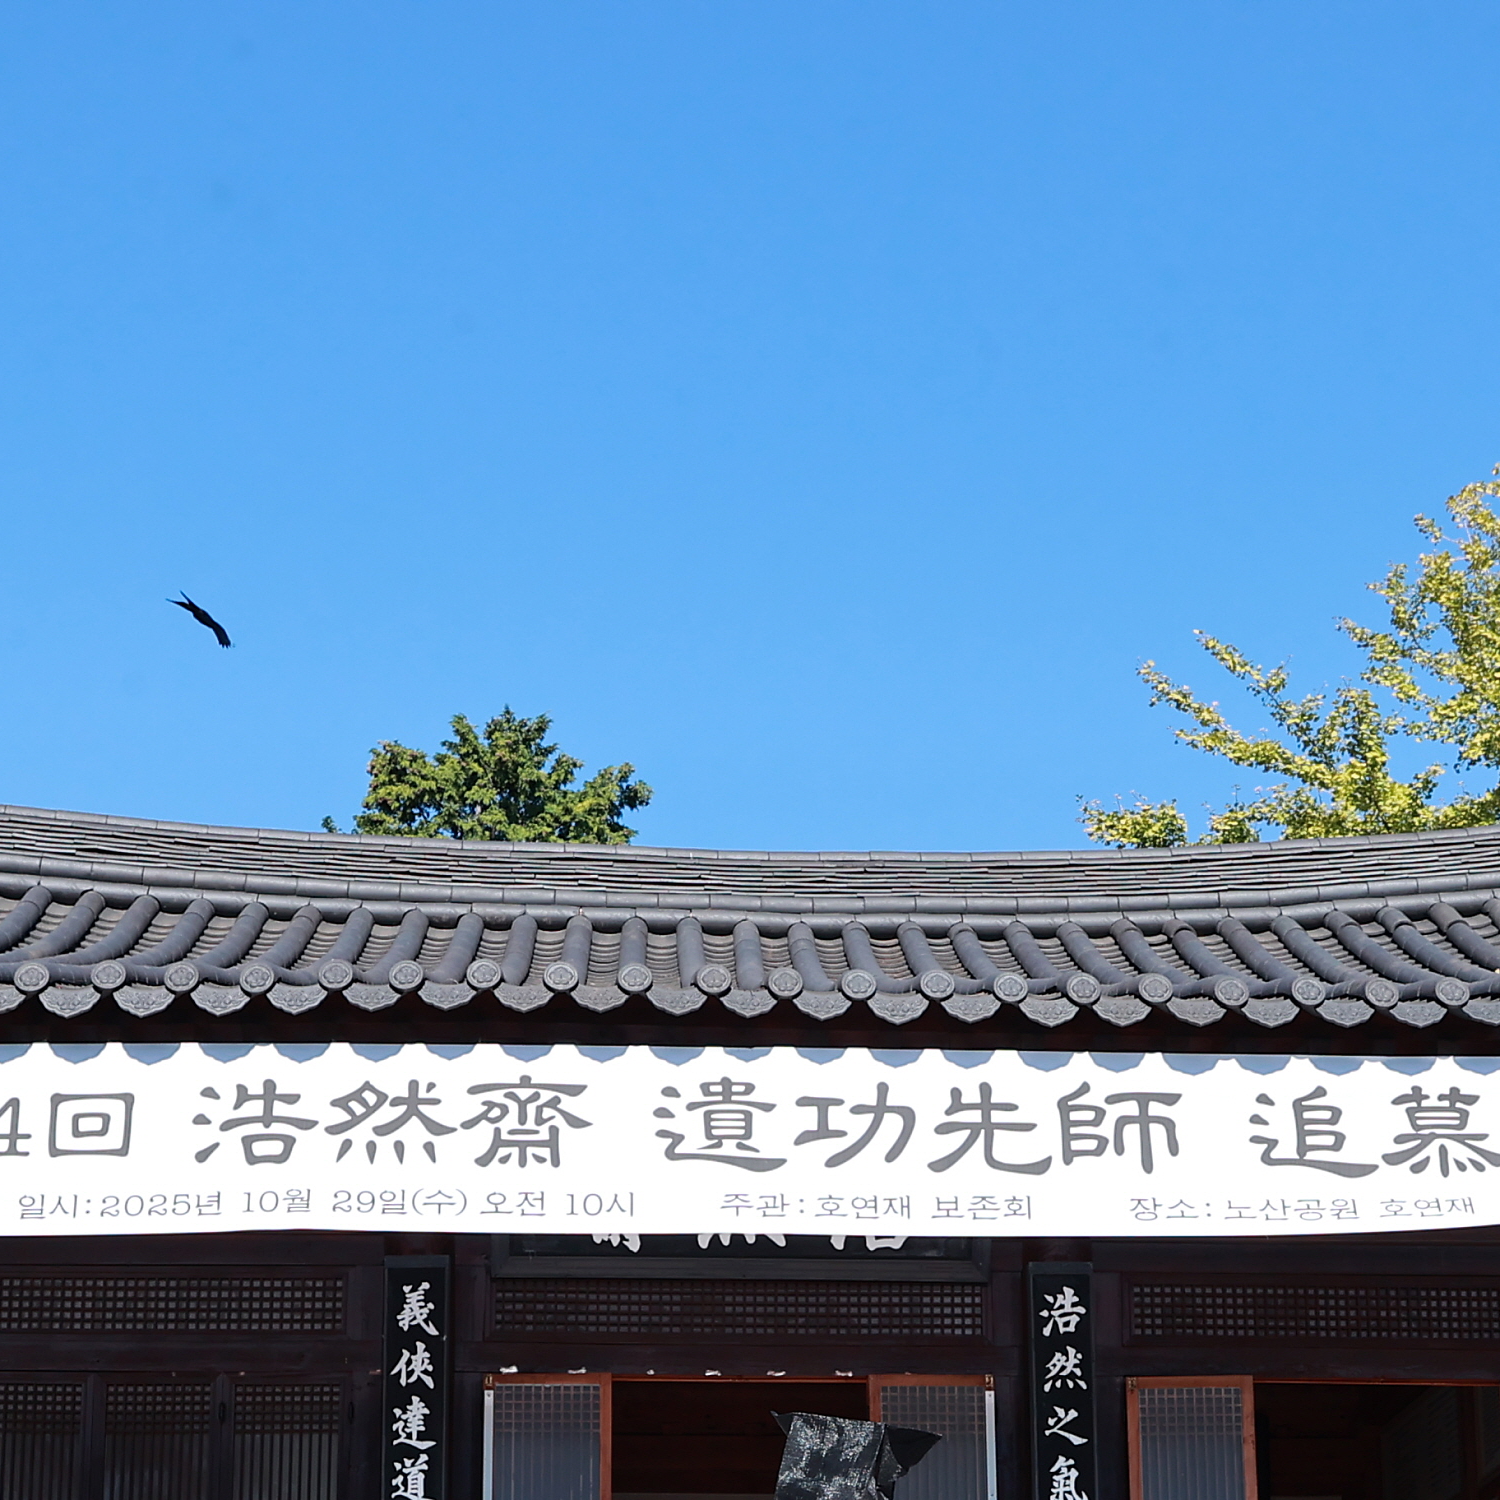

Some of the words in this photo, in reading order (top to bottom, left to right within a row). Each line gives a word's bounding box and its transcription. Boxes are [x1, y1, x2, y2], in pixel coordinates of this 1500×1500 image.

[652, 1076, 1182, 1176] 遺功先師
[242, 1188, 311, 1214] 10월
[331, 1188, 468, 1217] 29일(수)
[479, 1190, 546, 1217] 오전
[566, 1191, 634, 1217] 10시
[931, 1194, 1032, 1221] 보존회
[1379, 1196, 1475, 1218] 호연재
